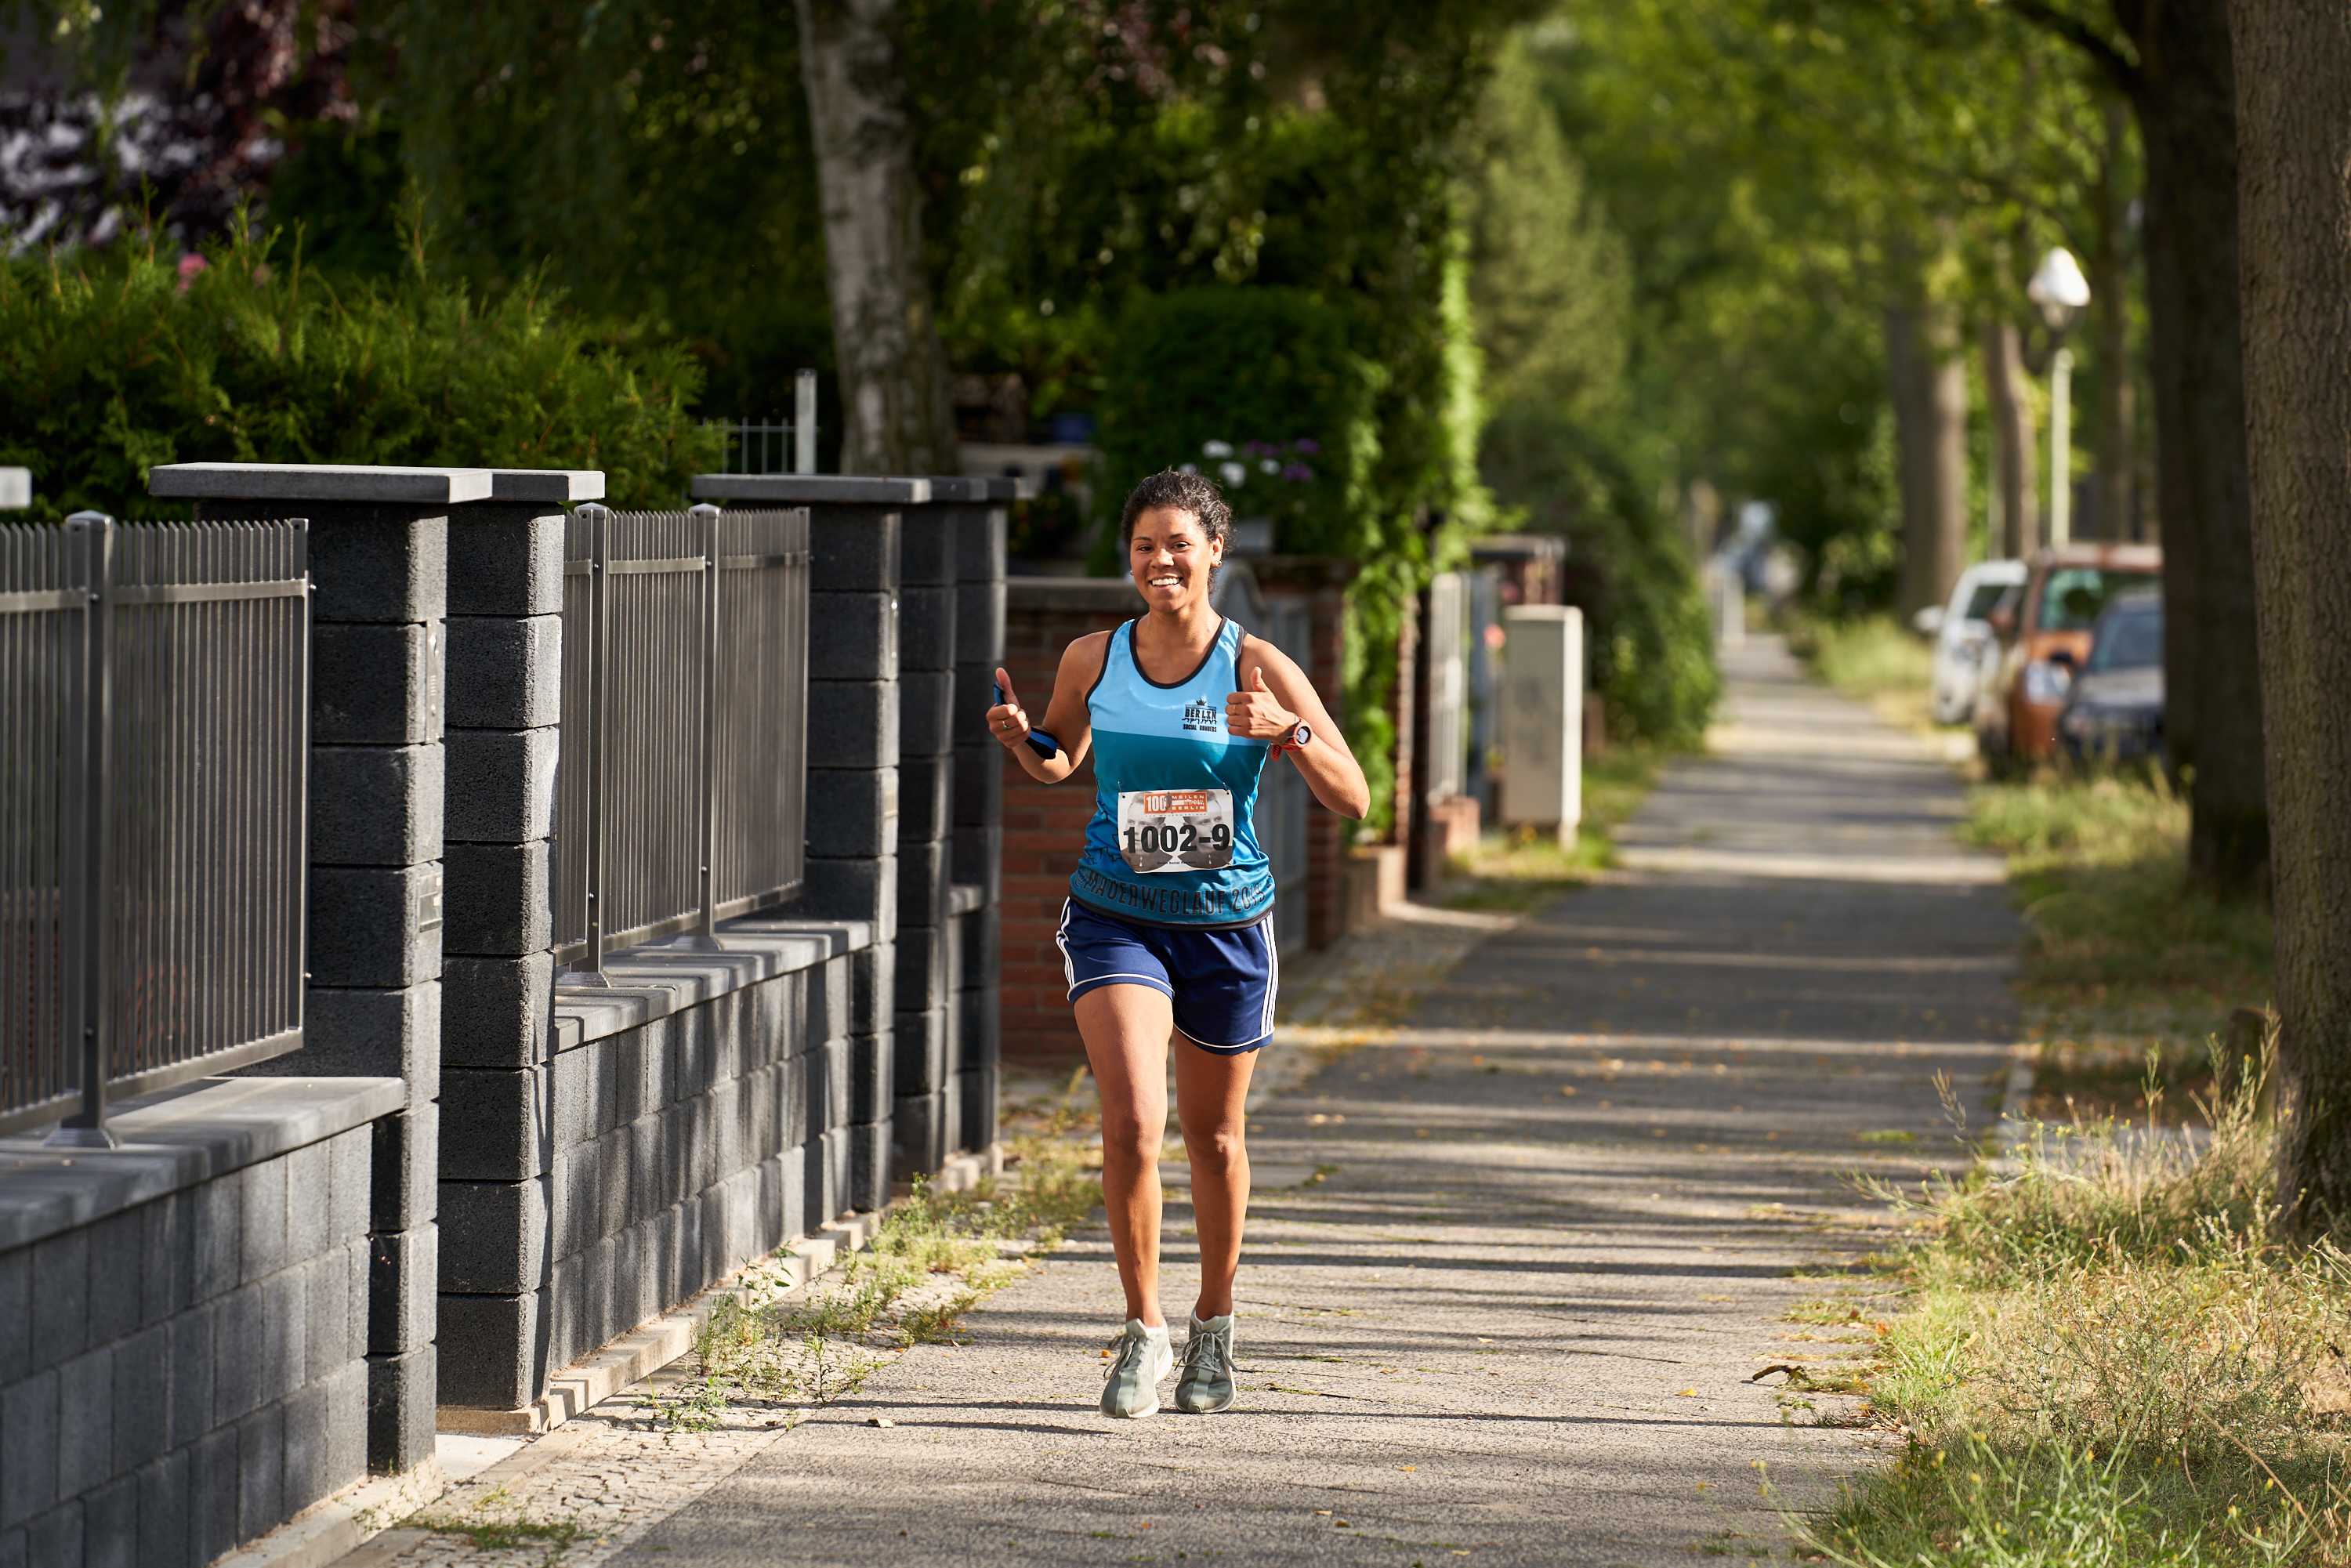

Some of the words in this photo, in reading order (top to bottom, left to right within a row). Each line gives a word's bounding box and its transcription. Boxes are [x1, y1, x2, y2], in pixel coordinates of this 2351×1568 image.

[1185, 708, 1217, 719] BERLIN
[1146, 795, 1167, 812] 100
[1123, 824, 1230, 853] 1002-9
